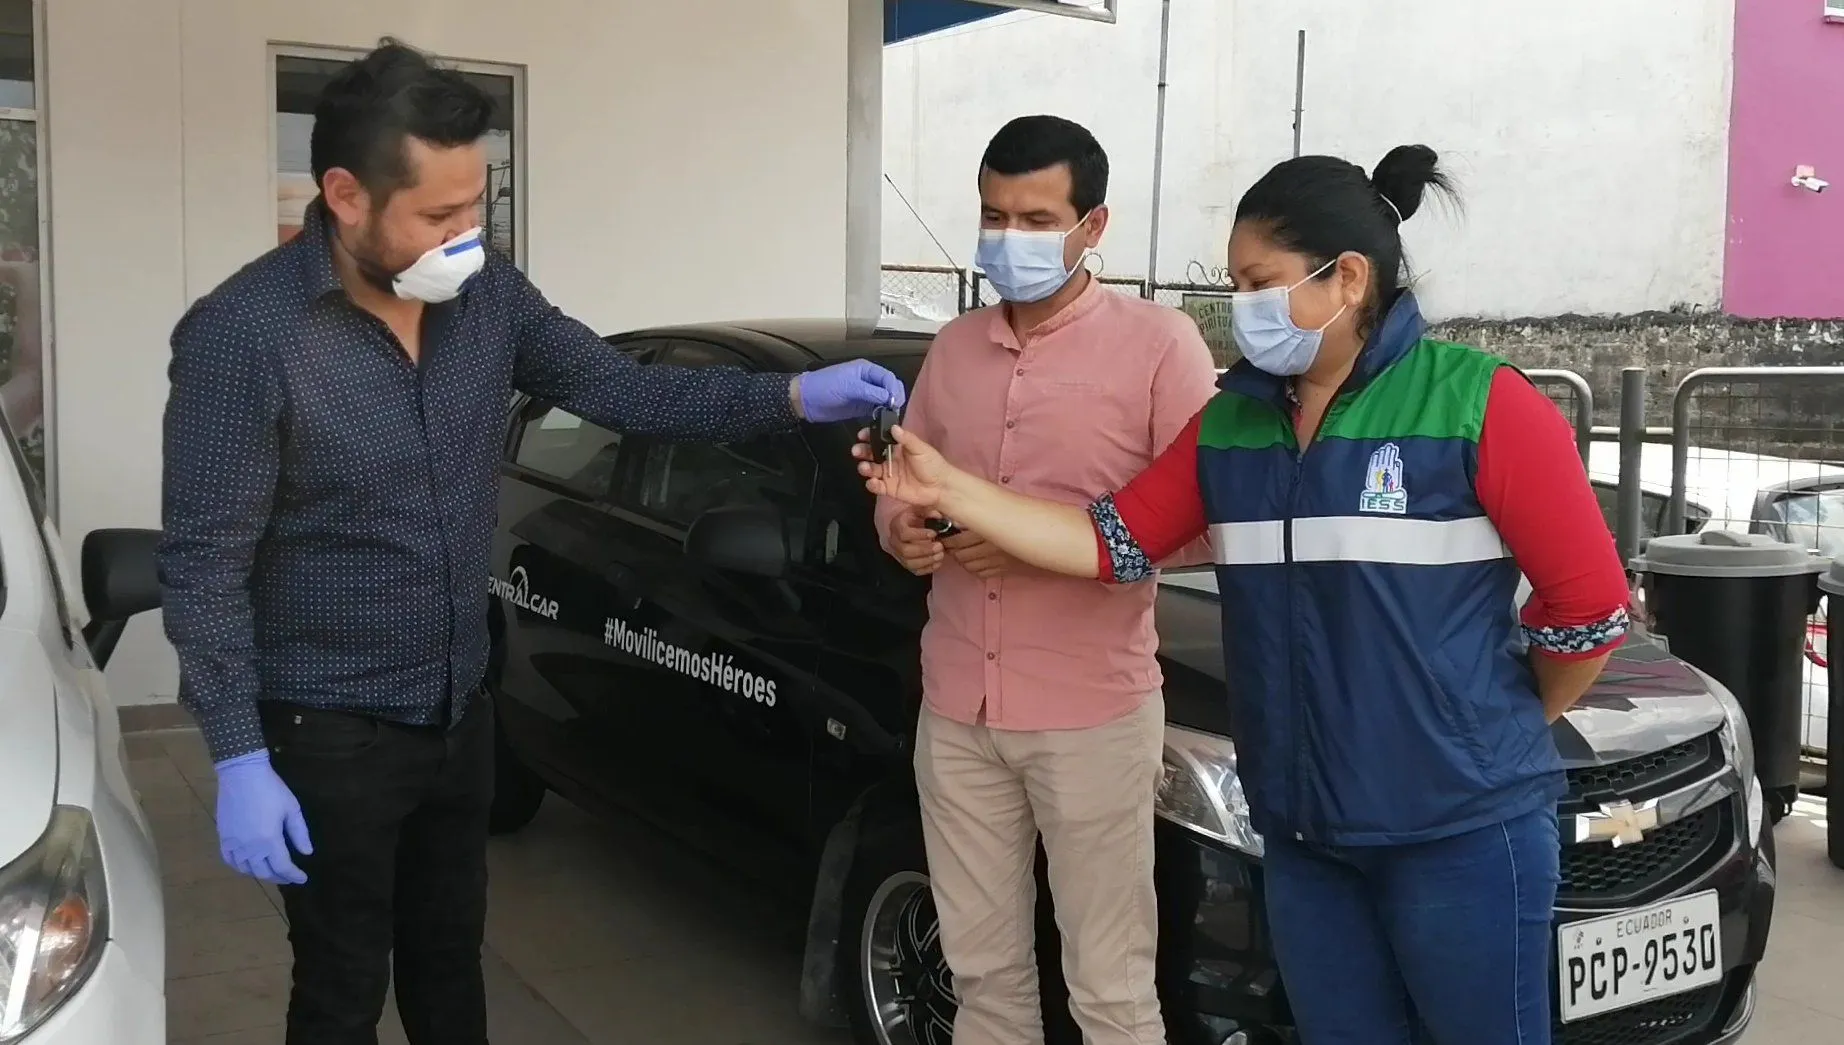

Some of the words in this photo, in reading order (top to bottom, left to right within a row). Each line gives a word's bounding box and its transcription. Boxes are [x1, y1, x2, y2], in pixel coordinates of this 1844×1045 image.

[1361, 498, 1404, 511] IESS
[488, 566, 559, 620] ENTRALCAR
[604, 617, 776, 707] #MovilicemosHéroes
[1617, 909, 1672, 938] ECUADOR
[1568, 924, 1716, 1006] PCP-9530
